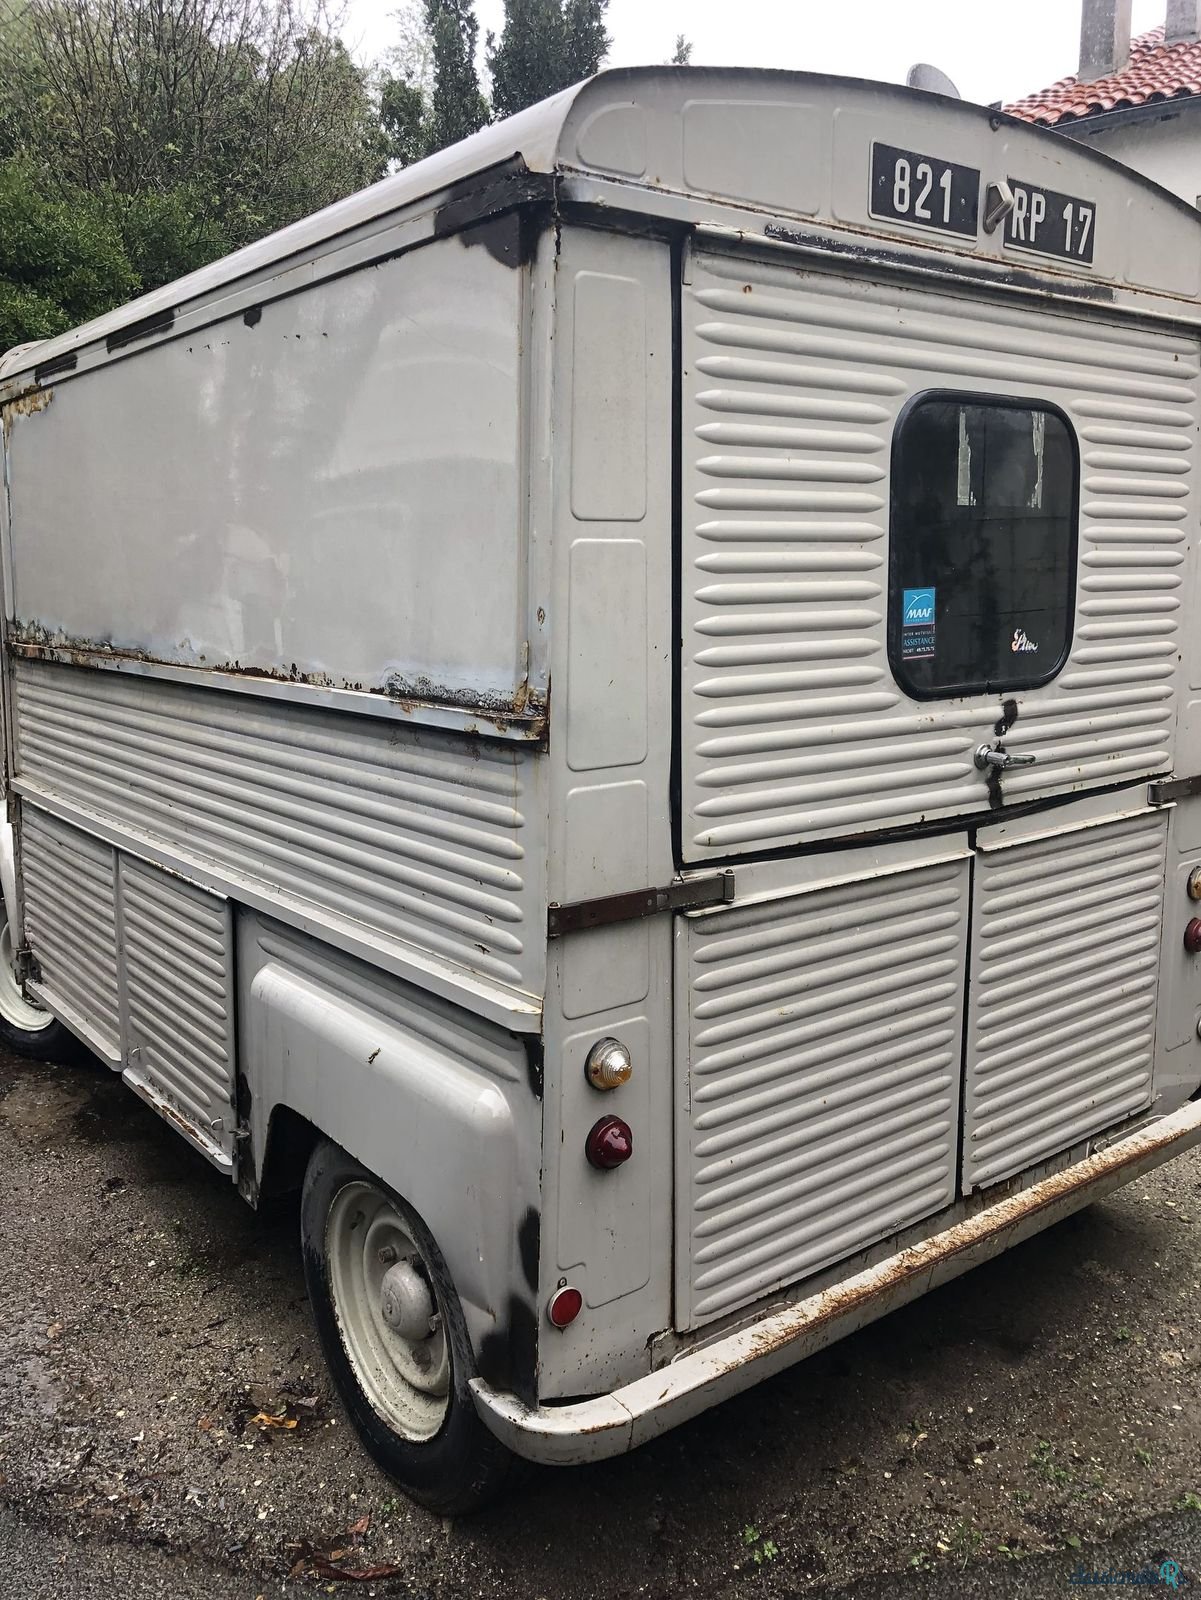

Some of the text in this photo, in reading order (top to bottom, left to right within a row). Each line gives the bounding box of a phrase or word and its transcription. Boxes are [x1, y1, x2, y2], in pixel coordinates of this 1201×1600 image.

[893, 158, 1093, 255] 821 RP 17
[906, 608, 933, 619] MAAF
[903, 637, 936, 647] ASSISTANCE
